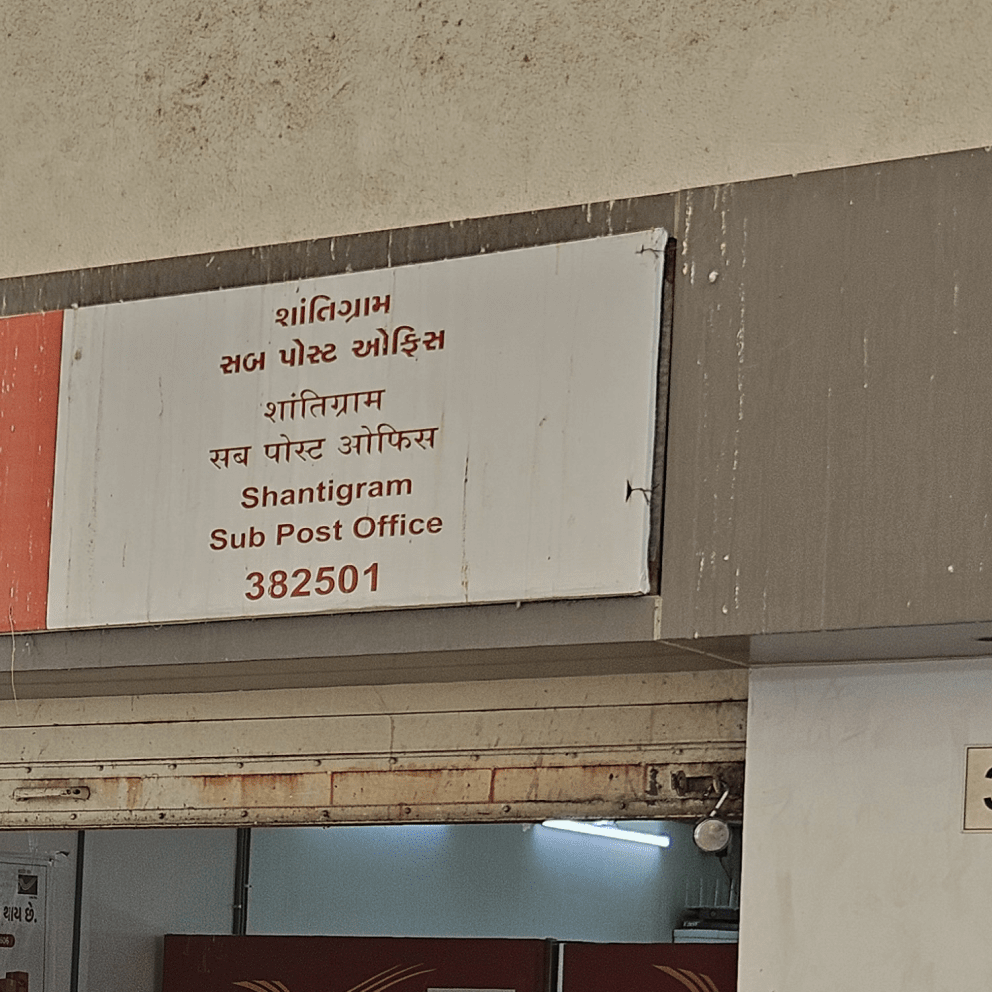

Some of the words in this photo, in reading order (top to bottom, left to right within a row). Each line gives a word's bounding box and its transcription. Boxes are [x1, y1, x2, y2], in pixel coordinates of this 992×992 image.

[275, 294, 390, 327] શાંતિગ્રામ
[219, 352, 265, 374] સબ
[279, 338, 337, 367] પોસ્ટ
[351, 325, 445, 358] ઓફિસ
[264, 389, 386, 423] शांतिग्राम
[209, 446, 252, 469] सब
[264, 434, 326, 464] पोस्ट
[337, 423, 439, 455] ओफिस
[241, 478, 412, 509] Shantigram
[209, 526, 265, 551] Sub
[276, 519, 342, 546] Post
[353, 513, 443, 539] Office
[244, 562, 379, 601] 382501
[3, 905, 22, 921] થાય
